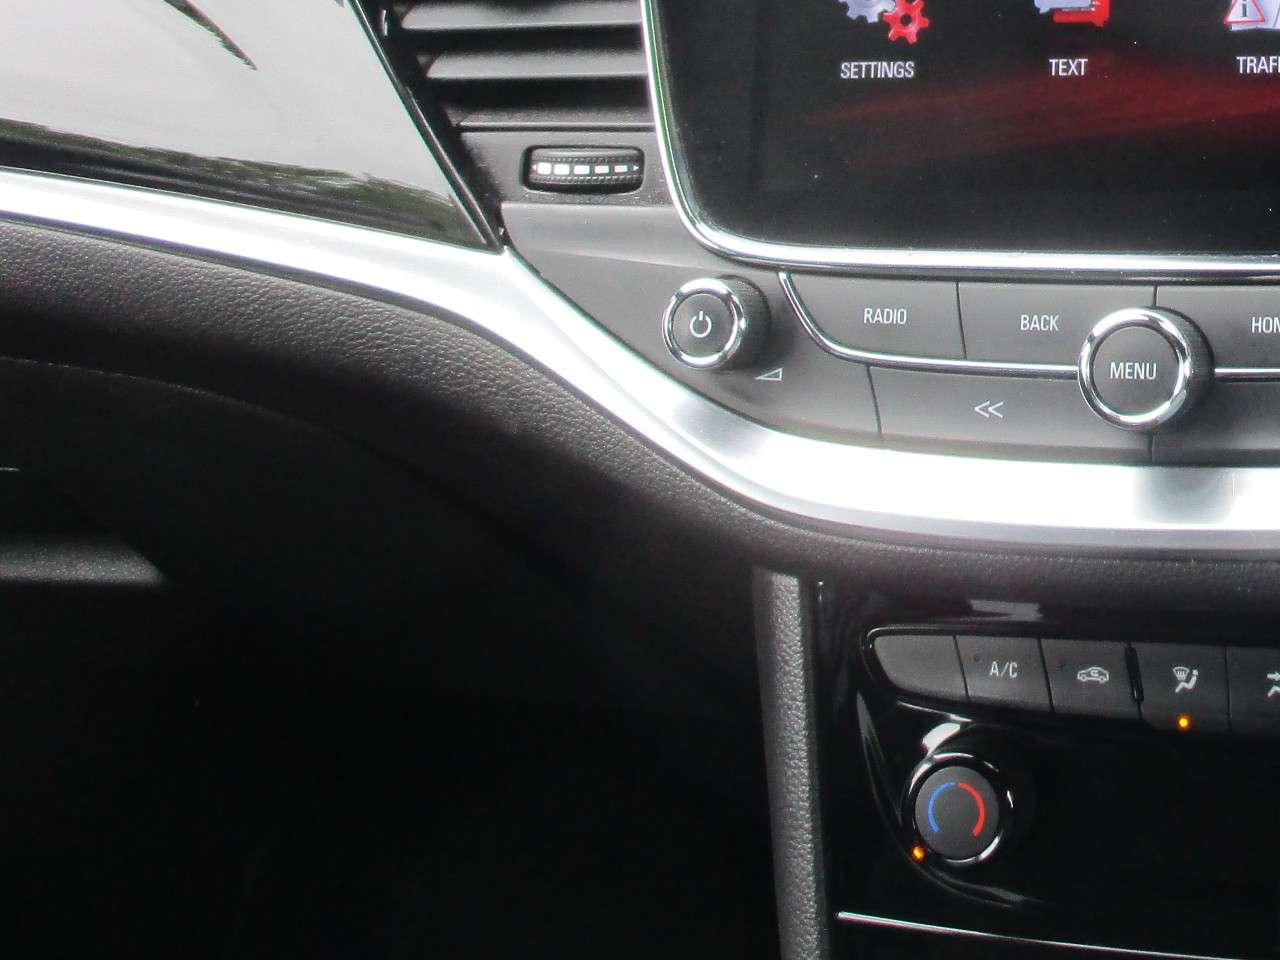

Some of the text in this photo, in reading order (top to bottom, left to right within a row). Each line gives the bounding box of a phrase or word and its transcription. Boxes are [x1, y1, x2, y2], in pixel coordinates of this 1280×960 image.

[840, 60, 915, 79] SETTINGS
[1048, 57, 1089, 77] TEXT
[862, 307, 908, 326] RADIO
[1019, 313, 1060, 332] BACK
[1108, 360, 1157, 381] MENU
[989, 660, 1019, 679] A/C
